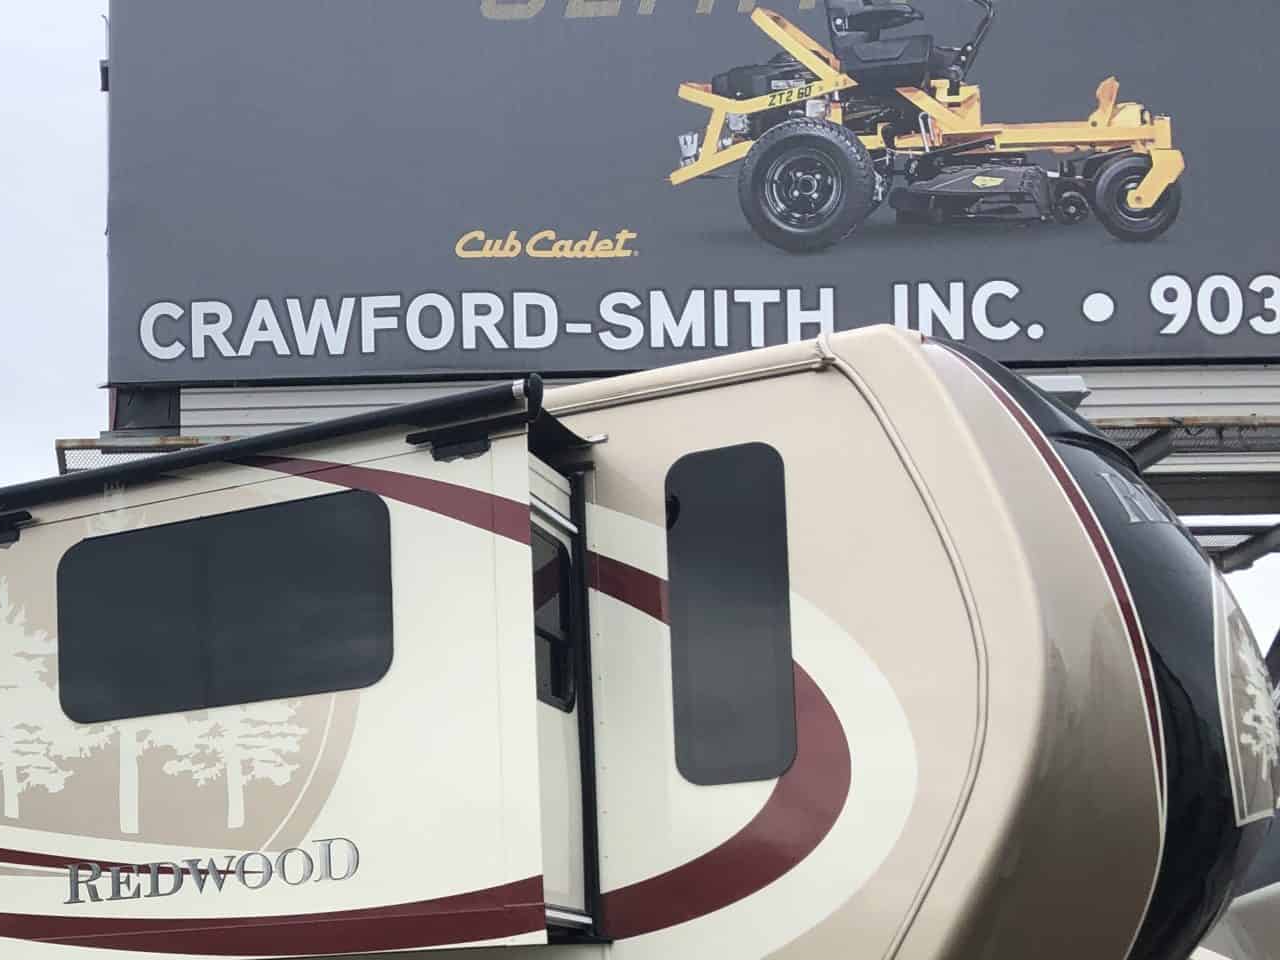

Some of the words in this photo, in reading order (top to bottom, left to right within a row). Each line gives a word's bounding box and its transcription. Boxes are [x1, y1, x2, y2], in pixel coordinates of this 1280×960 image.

[455, 230, 522, 258] Cub
[526, 229, 637, 258] Cadet
[139, 287, 835, 361] CRAWFORD-SMITH
[893, 280, 1045, 341] INC.
[1150, 274, 1280, 335] 903
[63, 837, 359, 904] REDWOOD
